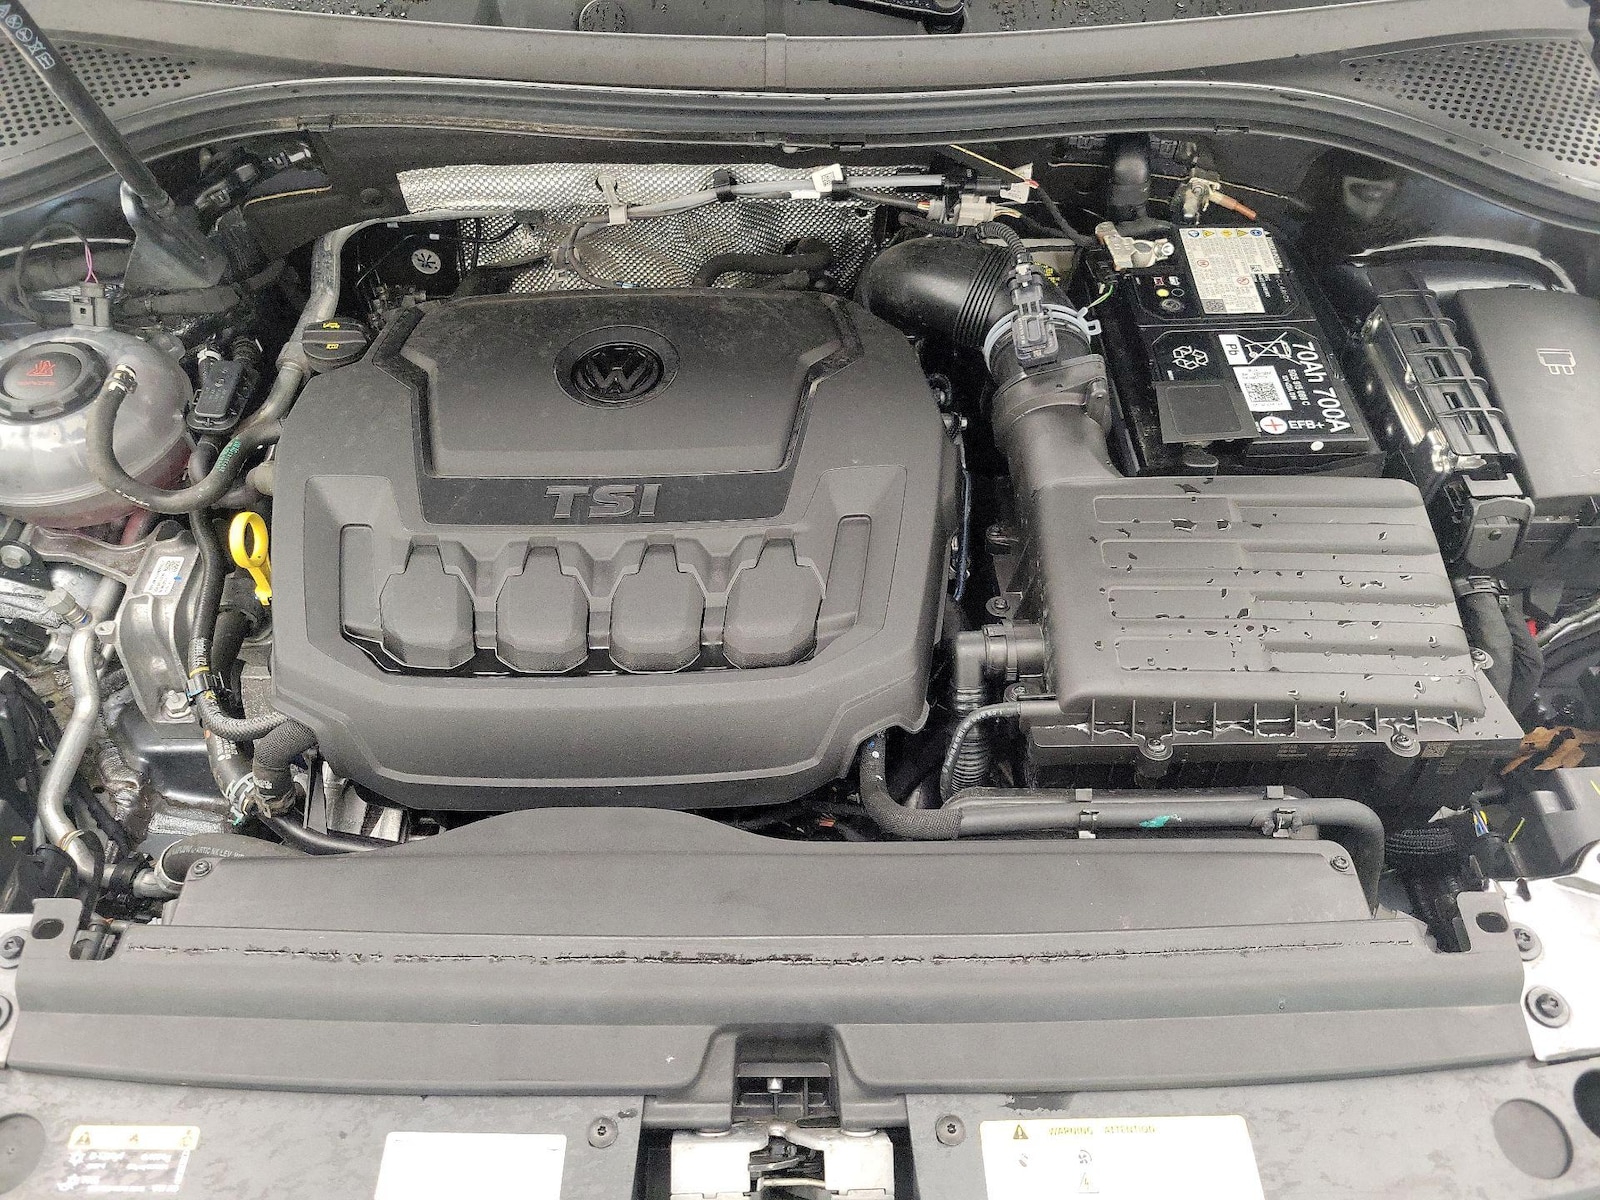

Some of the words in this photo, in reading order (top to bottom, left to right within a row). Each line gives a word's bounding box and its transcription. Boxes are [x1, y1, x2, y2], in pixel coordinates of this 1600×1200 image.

[1226, 344, 1239, 355] Pb
[1292, 341, 1327, 383] 70Ah
[1312, 387, 1352, 433] 700A
[1287, 420, 1325, 430] EFB+
[544, 483, 662, 518] TSI
[1048, 1127, 1093, 1136] WARNING
[1104, 1125, 1156, 1134] ATTENTION
